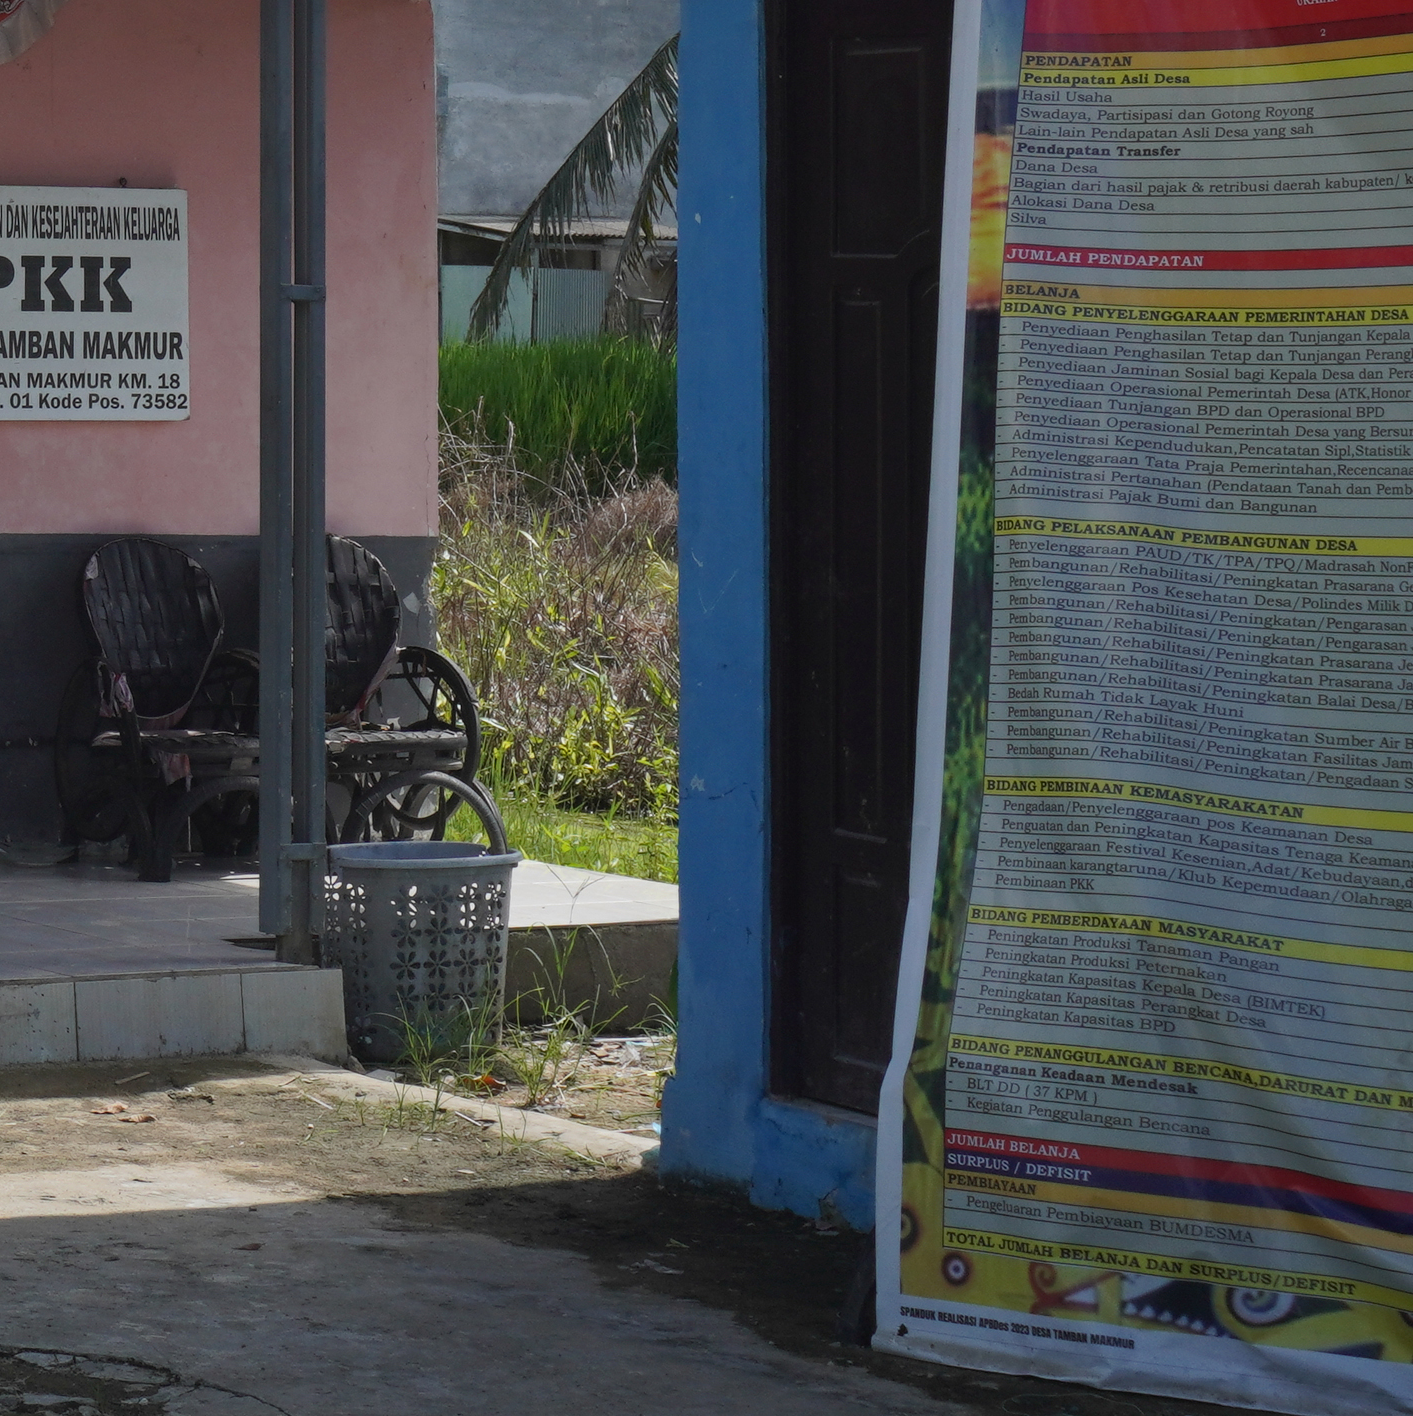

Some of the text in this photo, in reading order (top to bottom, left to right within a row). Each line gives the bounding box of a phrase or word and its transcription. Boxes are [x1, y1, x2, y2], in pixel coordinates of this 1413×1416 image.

[1024, 55, 1132, 67] PENDAPATAN
[1023, 72, 1190, 87] Pendapatan Asli Desa
[1022, 89, 1112, 103] Hasil Usaha
[6, 205, 28, 239] DAN
[32, 205, 120, 240] KESEJAHTERAAN
[124, 207, 180, 241] KELUARGA
[1010, 212, 1046, 225] Silva
[1007, 248, 1203, 268] JUMLAH PENDAPATAN
[1004, 284, 1080, 300] BELANJA
[1003, 302, 1409, 323] BIDANG PENYELENGGARAAN PEMERINTAHAN DESA
[83, 331, 183, 360] MAKMUR
[27, 373, 112, 389] MAKMUR
[118, 373, 151, 389] KM.
[158, 373, 180, 389] 18
[10, 393, 33, 409] 01
[39, 393, 82, 409] Kode
[88, 393, 123, 409] Pos.
[131, 393, 188, 410] 73582
[947, 1132, 1081, 1160] JUMLAH BELANJA
[947, 1153, 1009, 1172] SURPLUS
[1025, 1163, 1091, 1181] DEFISIT
[900, 1306, 1135, 1350] SPANDUK REALISASI APBDes 2023 DESA TAMBAN MAKMUR
